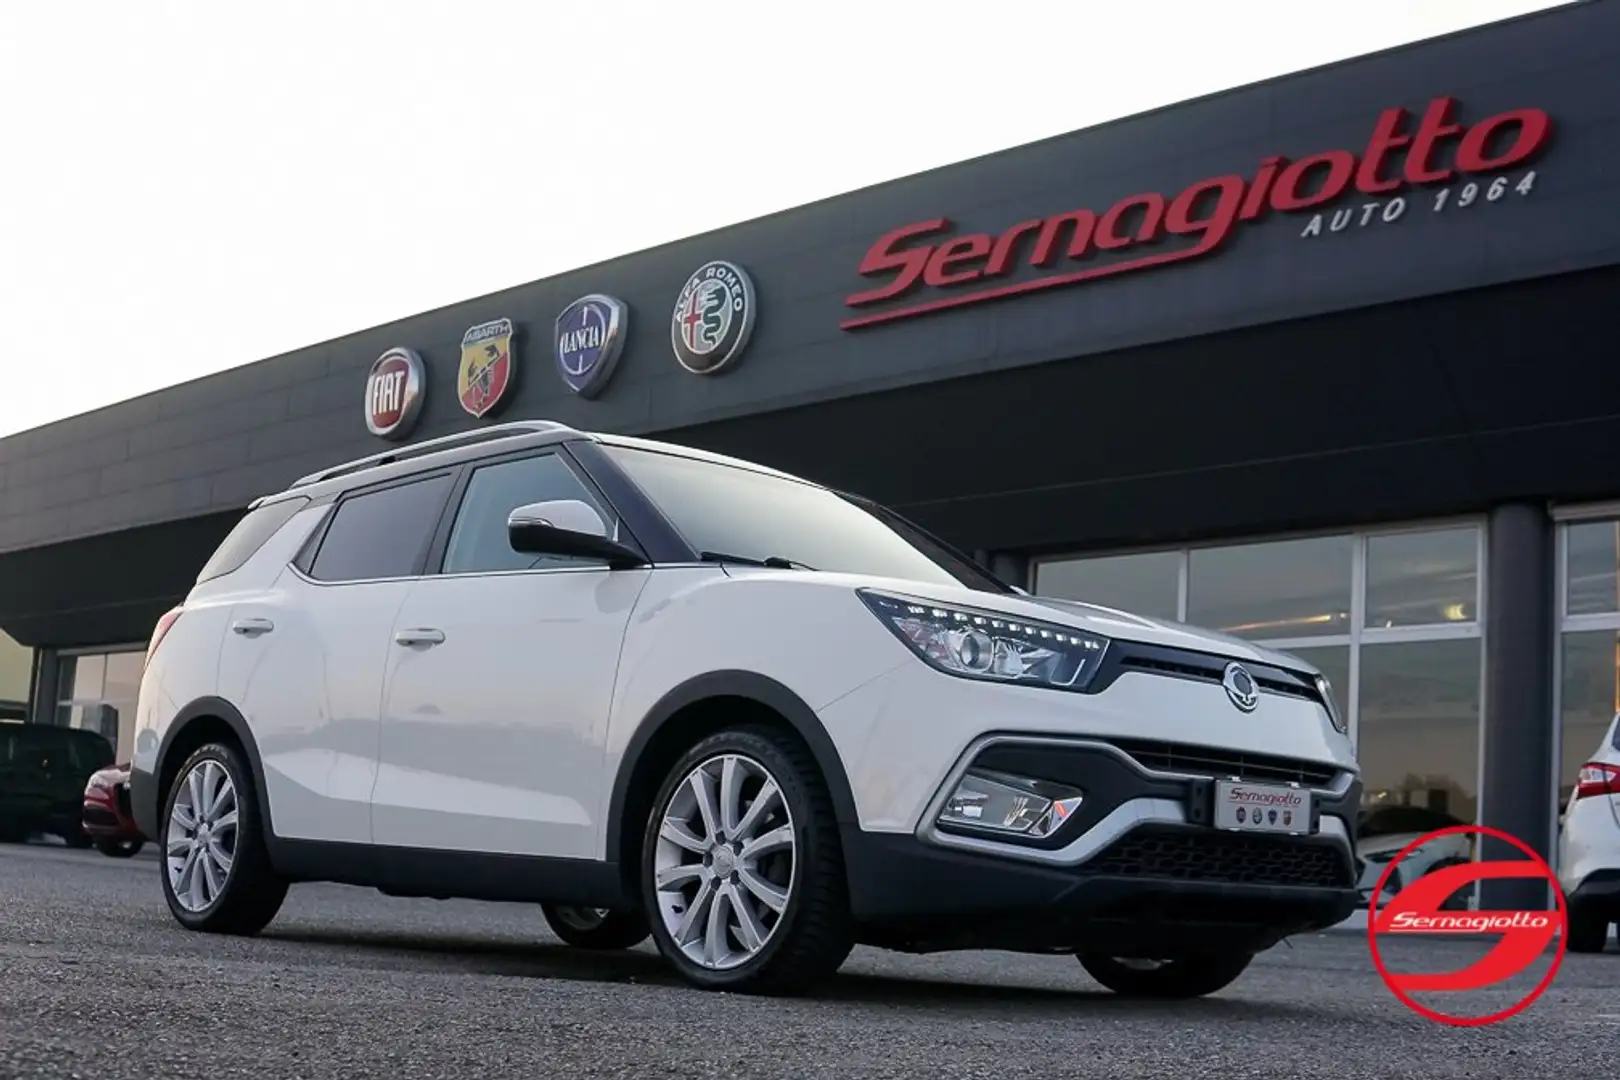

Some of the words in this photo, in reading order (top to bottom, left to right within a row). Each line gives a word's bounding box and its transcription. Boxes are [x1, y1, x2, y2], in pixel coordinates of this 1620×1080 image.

[840, 95, 1551, 330] Sernagiotto
[1301, 197, 1406, 237] AUTO
[1433, 171, 1537, 212] 1964
[706, 266, 743, 312] ROMEO
[466, 324, 510, 342] ABARTH
[562, 325, 600, 354] LANCIA
[373, 371, 405, 415] FIAT
